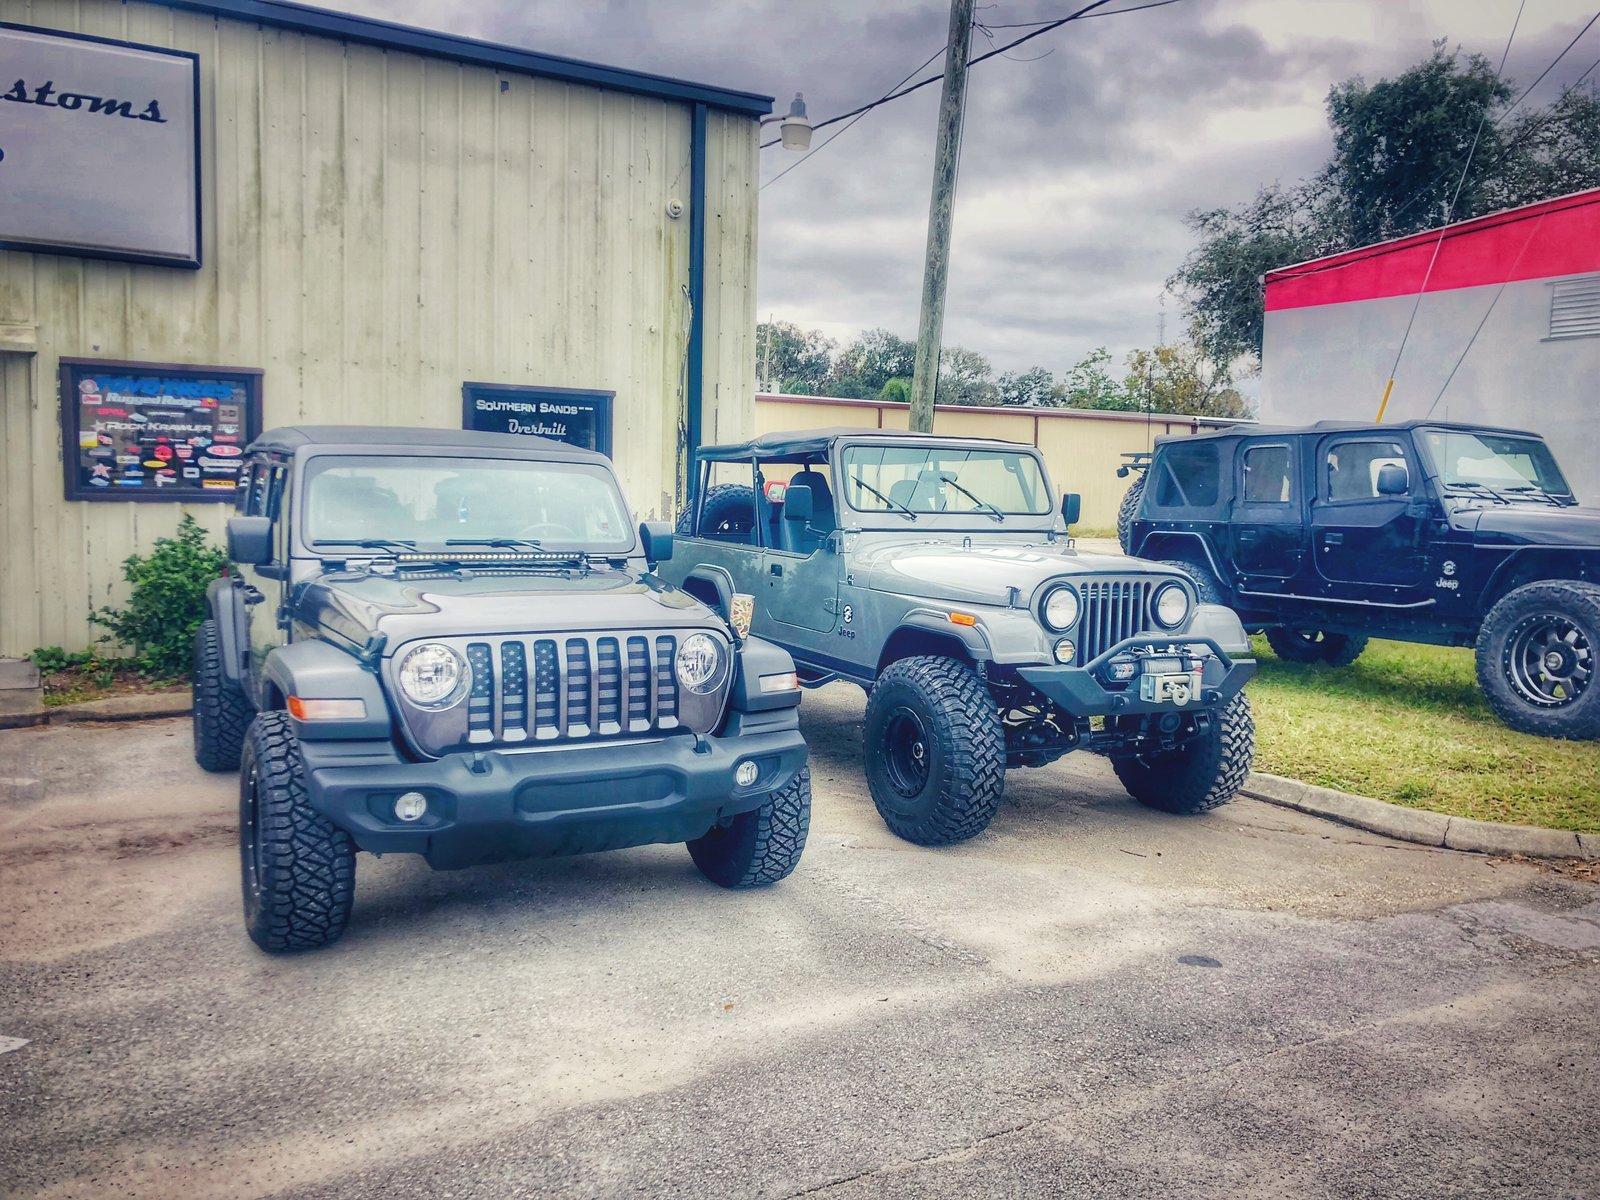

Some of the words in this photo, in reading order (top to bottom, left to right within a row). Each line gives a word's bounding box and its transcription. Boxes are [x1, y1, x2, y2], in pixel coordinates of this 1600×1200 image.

[0, 79, 167, 123] stoms
[106, 392, 160, 405] Rugged
[476, 399, 536, 413] SOUTHERN
[540, 402, 578, 415] SANDS
[106, 421, 147, 431] ROCK
[147, 422, 213, 433] KRAWLER
[508, 418, 567, 436] Overbuilt
[1435, 577, 1459, 590] Jeep
[838, 625, 856, 640] Jeep
